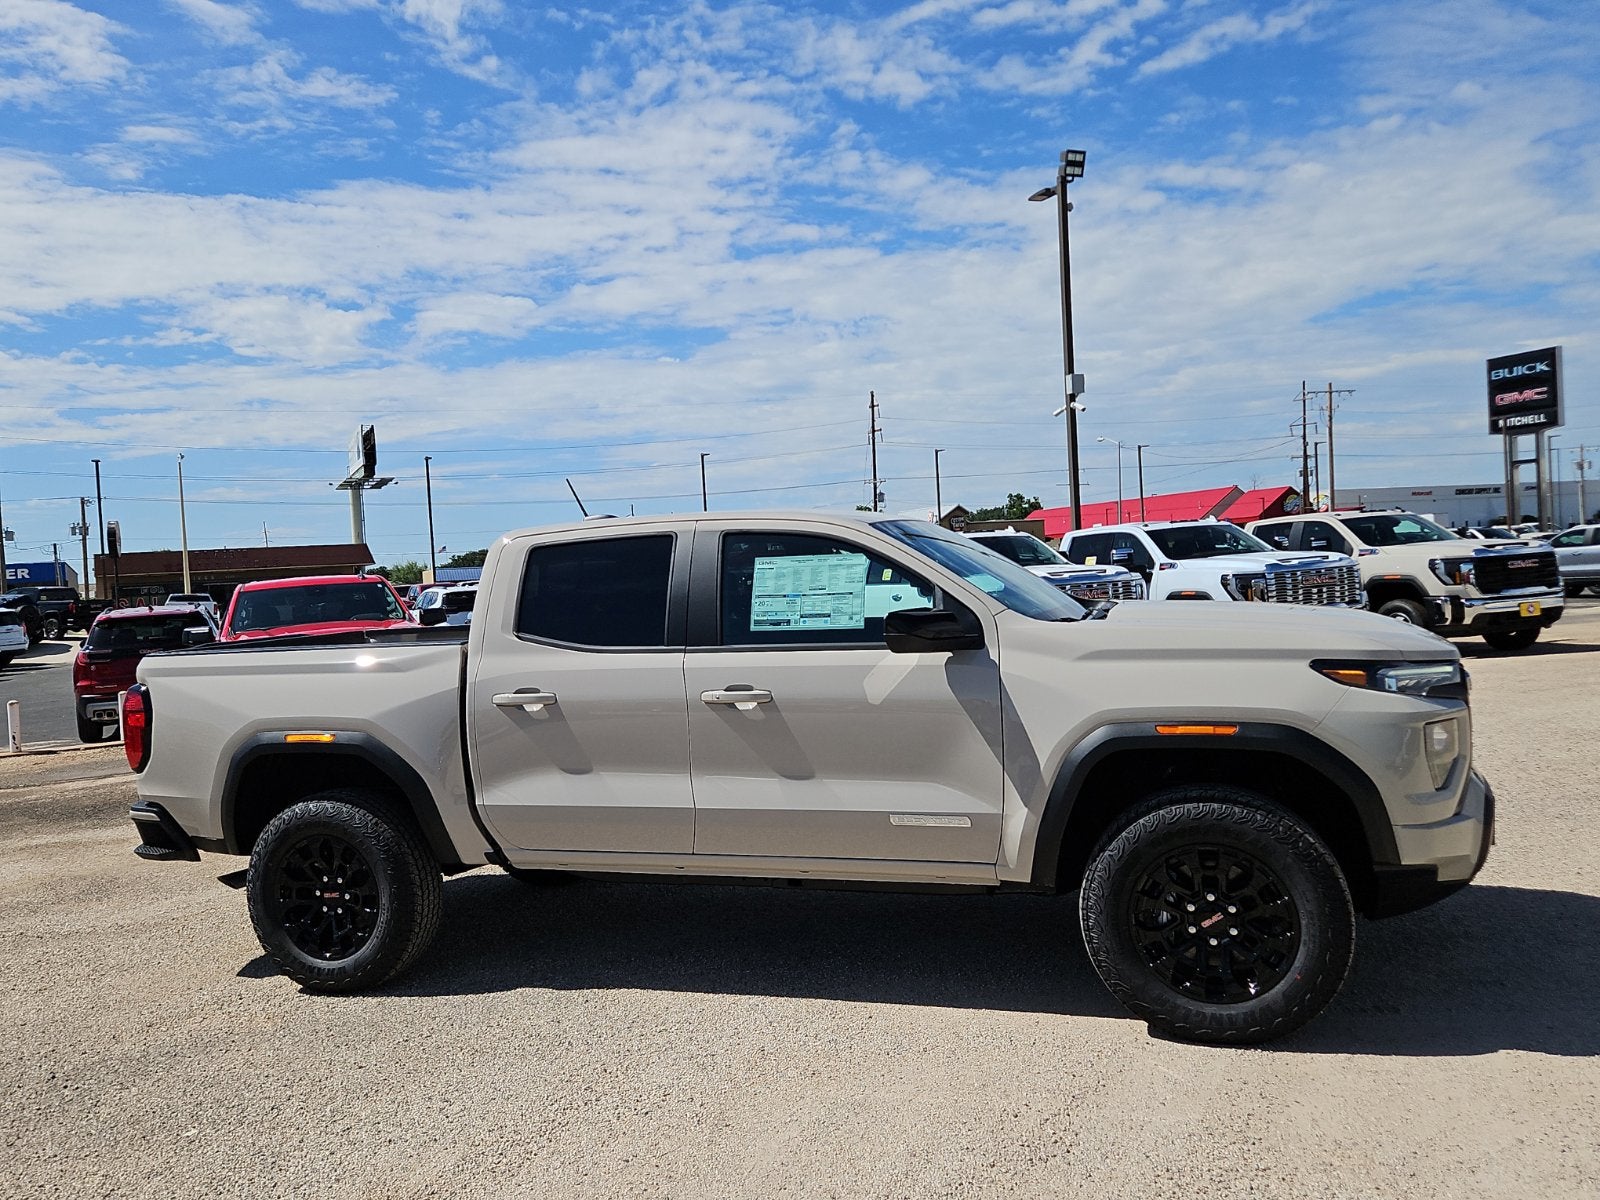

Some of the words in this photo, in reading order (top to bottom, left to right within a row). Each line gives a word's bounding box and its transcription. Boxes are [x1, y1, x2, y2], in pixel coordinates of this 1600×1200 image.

[1491, 360, 1551, 380] BUICK
[1495, 387, 1547, 406] GMC
[1507, 559, 1539, 568] GMC
[1303, 575, 1337, 585] GMC
[1071, 589, 1110, 600] GMC
[1200, 912, 1224, 928] GMC
